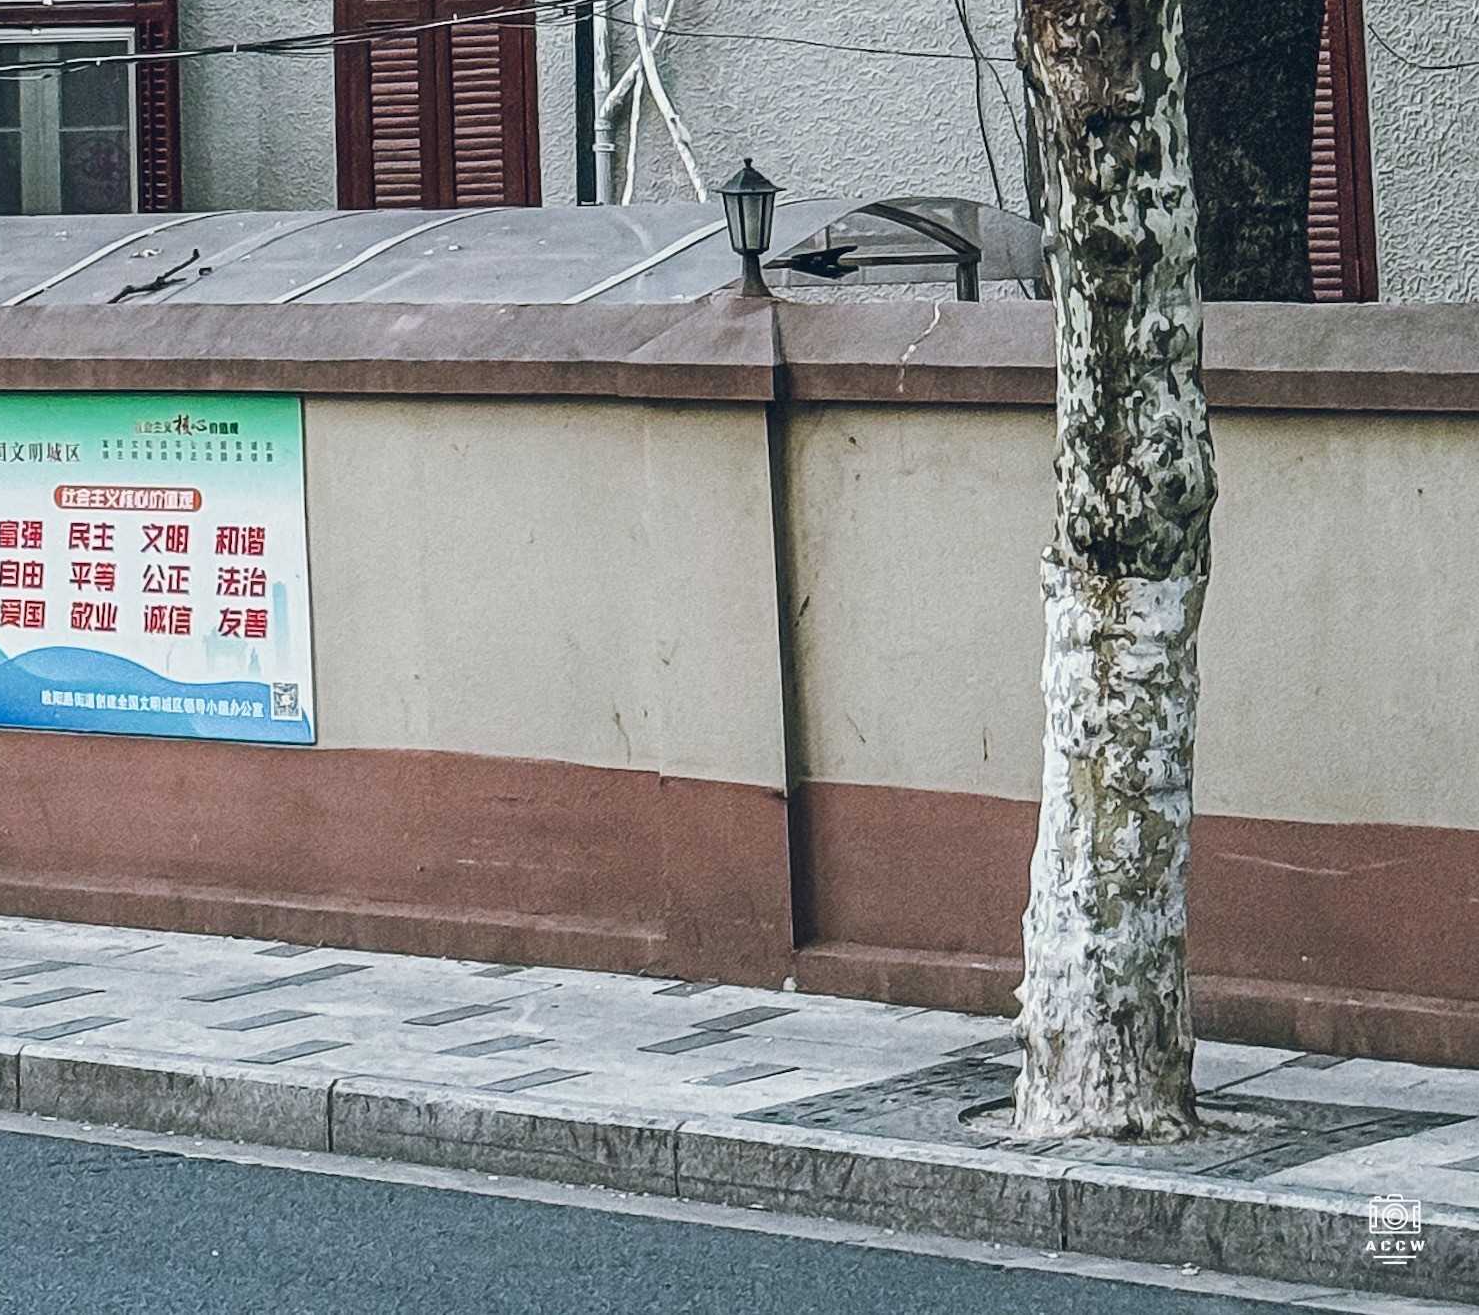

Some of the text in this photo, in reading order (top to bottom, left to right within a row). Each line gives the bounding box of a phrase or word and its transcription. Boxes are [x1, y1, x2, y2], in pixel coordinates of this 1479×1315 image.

[61, 487, 194, 510] 社会主义核心价值观
[69, 522, 115, 551] 民主
[140, 523, 189, 554] 文明
[215, 526, 266, 556] 和谐
[70, 561, 117, 592] 平等
[141, 564, 191, 595] 公正
[216, 567, 267, 598] 法治
[0, 598, 268, 639] 爱国 敬业 诚信 友善
